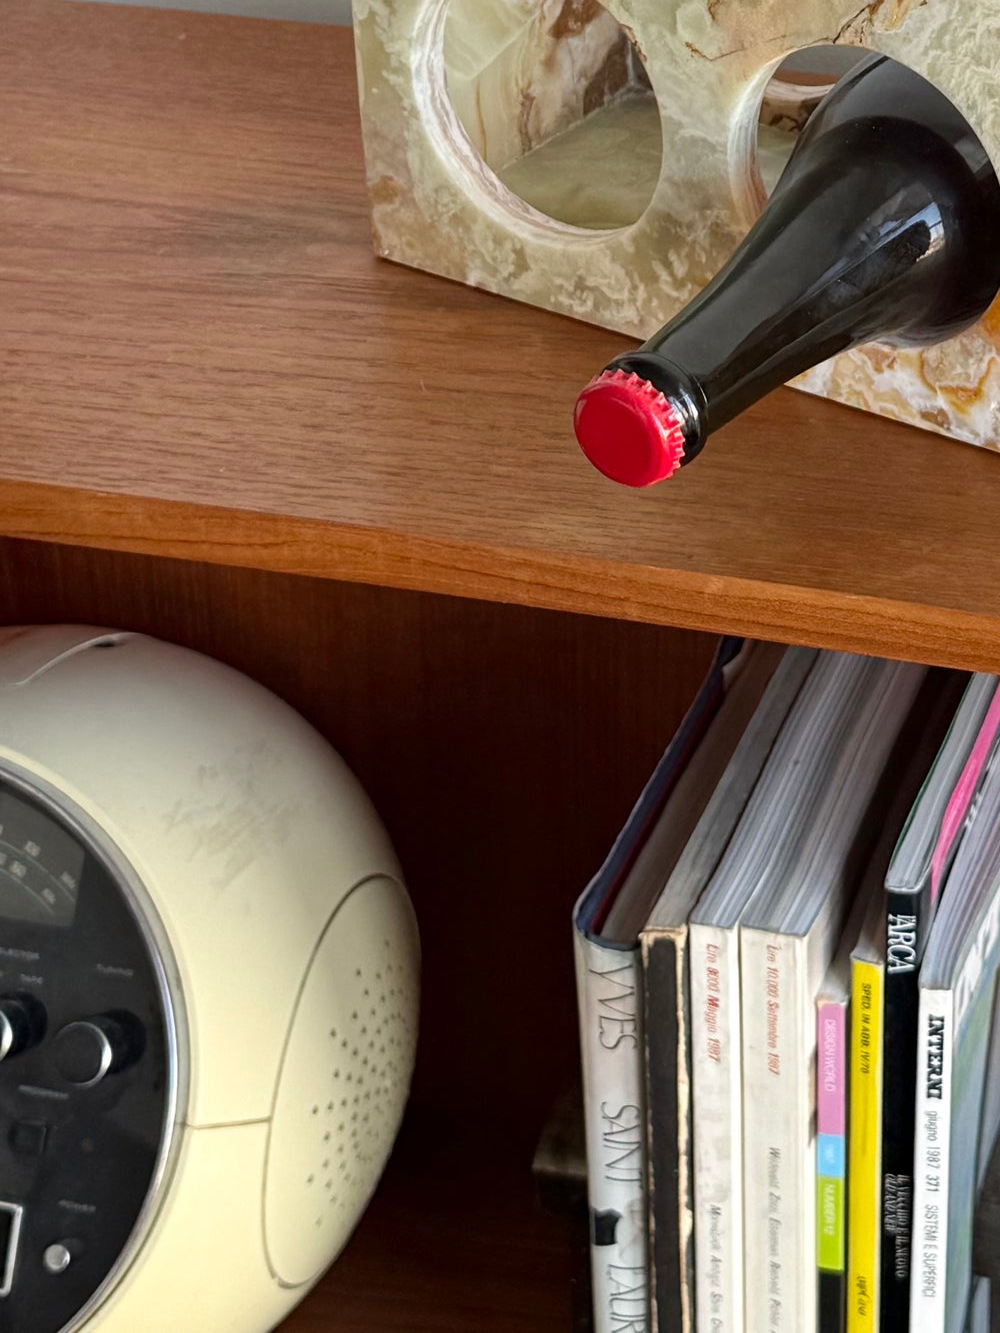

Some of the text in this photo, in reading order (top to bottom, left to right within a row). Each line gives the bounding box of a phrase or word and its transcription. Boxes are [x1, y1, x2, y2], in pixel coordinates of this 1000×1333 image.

[589, 963, 637, 1050] YVES
[704, 943, 721, 1063] Lire 8000 Maggio 1987
[766, 944, 780, 1075] Lire 10.000 Settembre 1987
[861, 982, 872, 1010] SPED.
[861, 1013, 871, 1024] IN
[926, 1014, 945, 1100] INTERNI
[601, 1101, 645, 1190] SAINT
[923, 1110, 939, 1141] giugno
[926, 1146, 941, 1169] 1987
[925, 1174, 940, 1192] 371
[923, 1204, 940, 1242] SISTEMI
[922, 1253, 938, 1298] SUPERFICI
